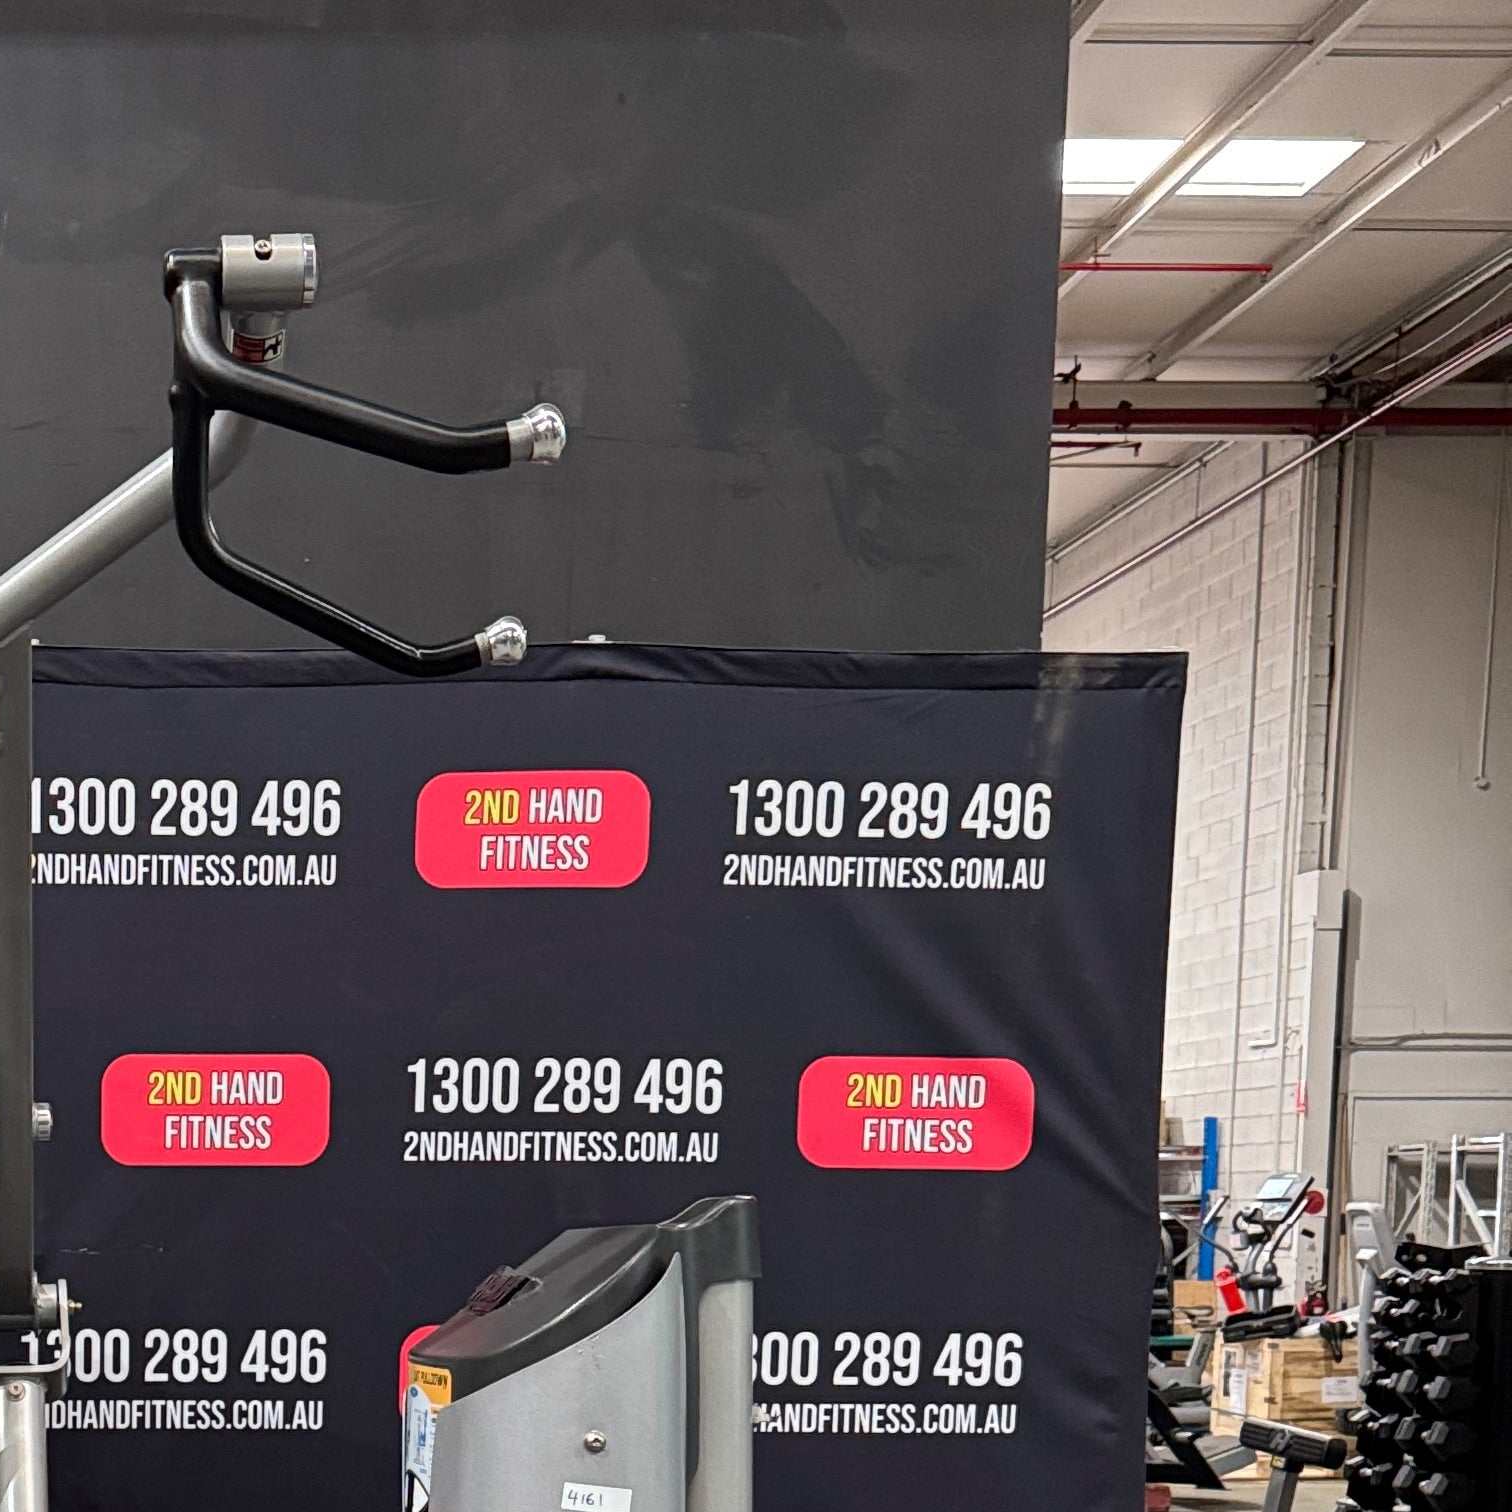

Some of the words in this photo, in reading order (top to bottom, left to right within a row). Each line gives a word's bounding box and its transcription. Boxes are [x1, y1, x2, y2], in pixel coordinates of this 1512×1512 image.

[151, 779, 237, 836] 289
[252, 780, 340, 836] 496
[465, 790, 519, 824] 2ND
[529, 789, 602, 823] HAND
[730, 780, 844, 837] 1300
[858, 782, 948, 839] 289
[961, 783, 1051, 839] 496
[481, 835, 589, 869] FITNESS
[723, 854, 1045, 889] 2NDHANDFITNESS.COM.AU
[149, 1072, 201, 1104] 2ND
[212, 1072, 282, 1104] HAND
[408, 1058, 519, 1113] 1300
[534, 1058, 620, 1113] 289
[634, 1059, 723, 1114] 496
[848, 1074, 901, 1107] 2ND
[912, 1075, 985, 1108] HAND
[166, 1116, 271, 1149] FITNESS
[404, 1131, 718, 1162] 2NDHANDFITNESS.COM.AU
[864, 1119, 972, 1153] FITNESS
[145, 1329, 227, 1382] 289
[241, 1329, 326, 1383] 496
[833, 1332, 920, 1386] 289
[933, 1333, 1022, 1386] 496
[567, 1489, 604, 1507] 4161
